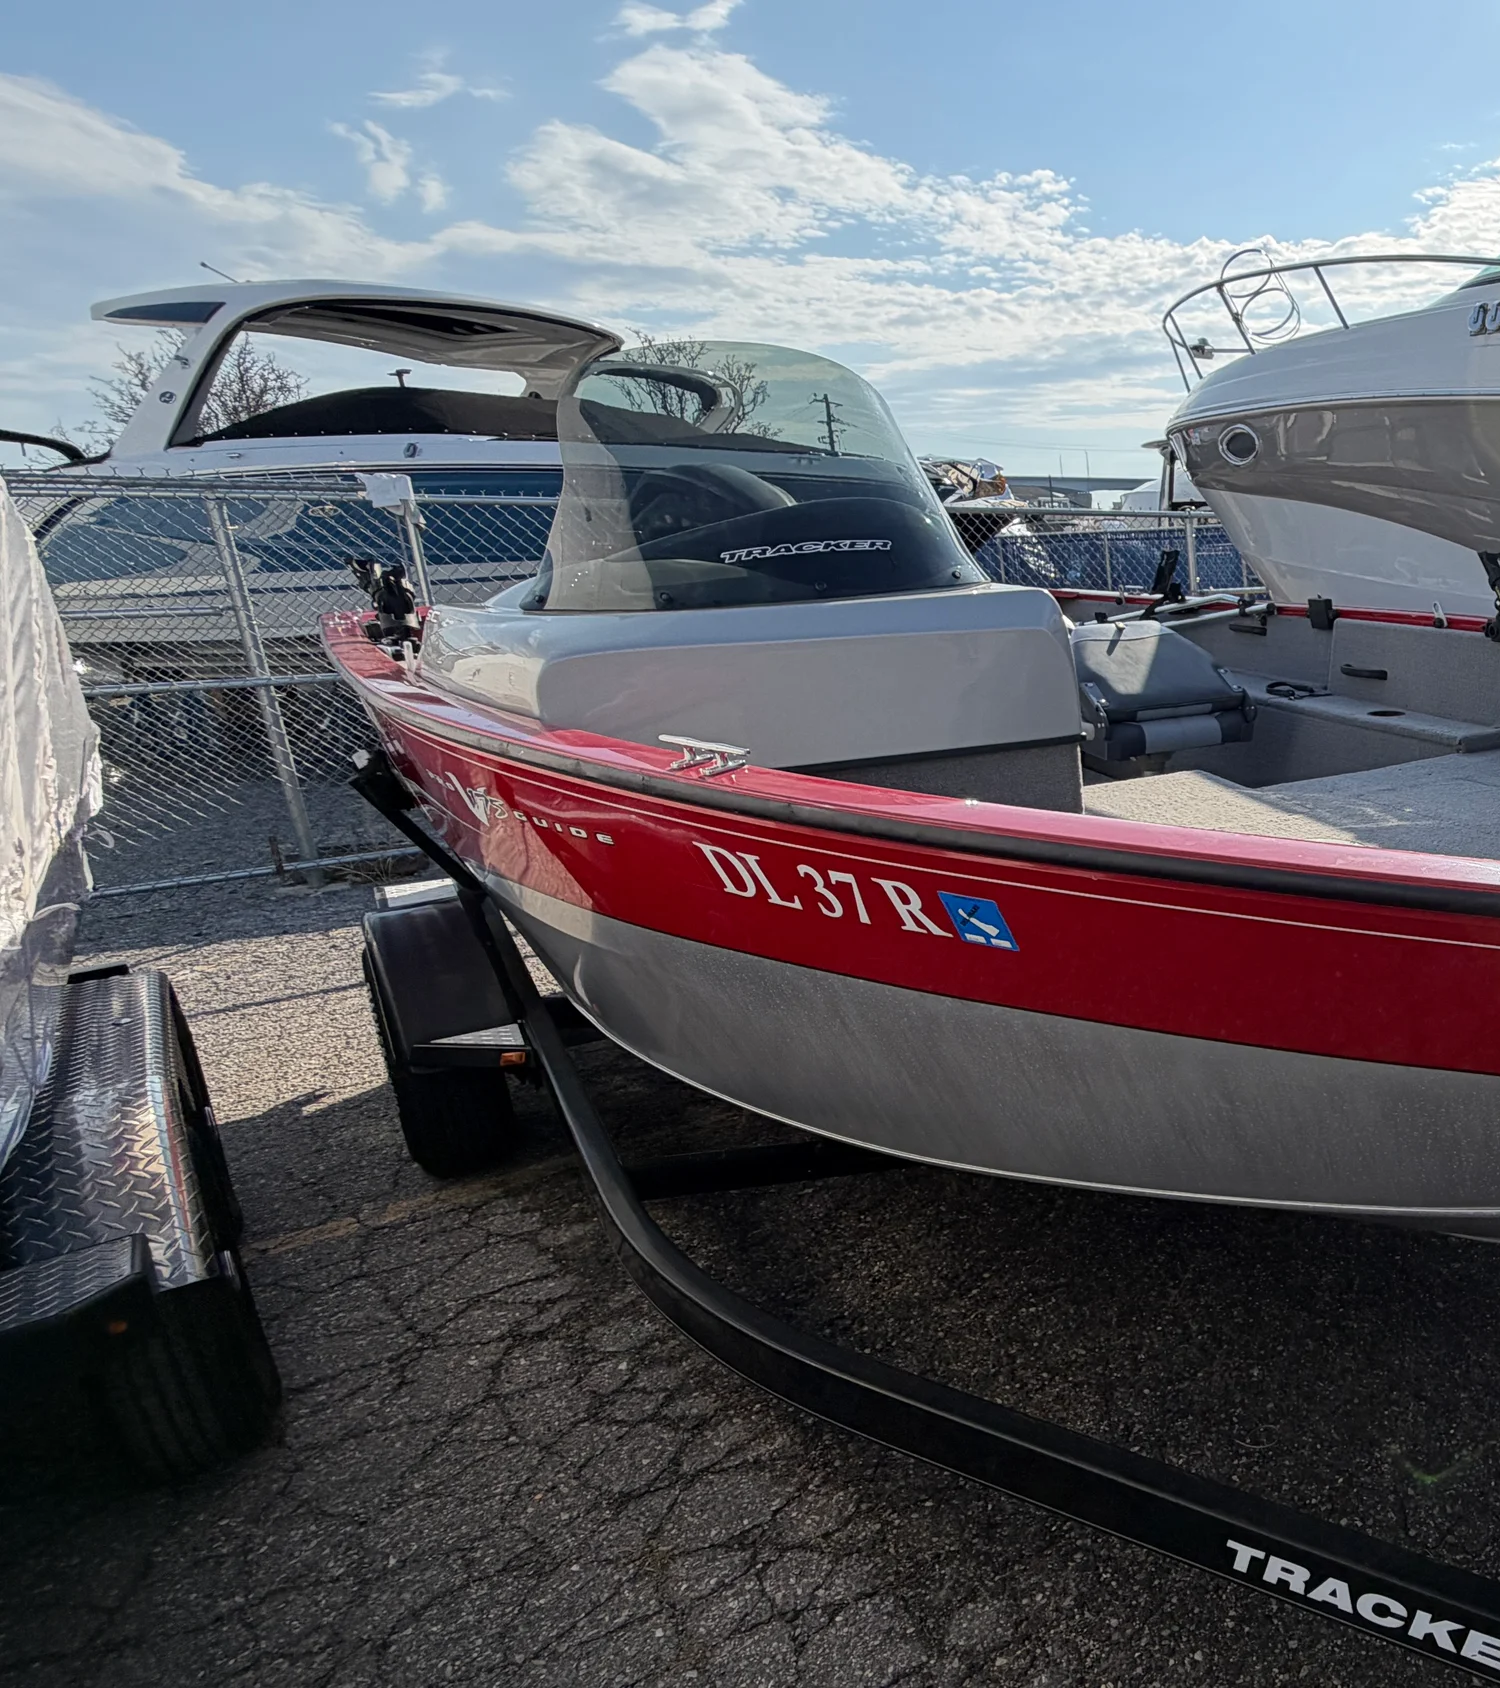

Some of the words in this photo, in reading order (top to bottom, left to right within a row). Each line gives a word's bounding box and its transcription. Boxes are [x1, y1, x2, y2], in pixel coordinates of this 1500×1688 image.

[720, 539, 892, 563] TRACKER
[513, 810, 616, 846] GUIDE
[692, 841, 803, 910] DL
[797, 864, 871, 925] 37
[871, 877, 954, 938] R
